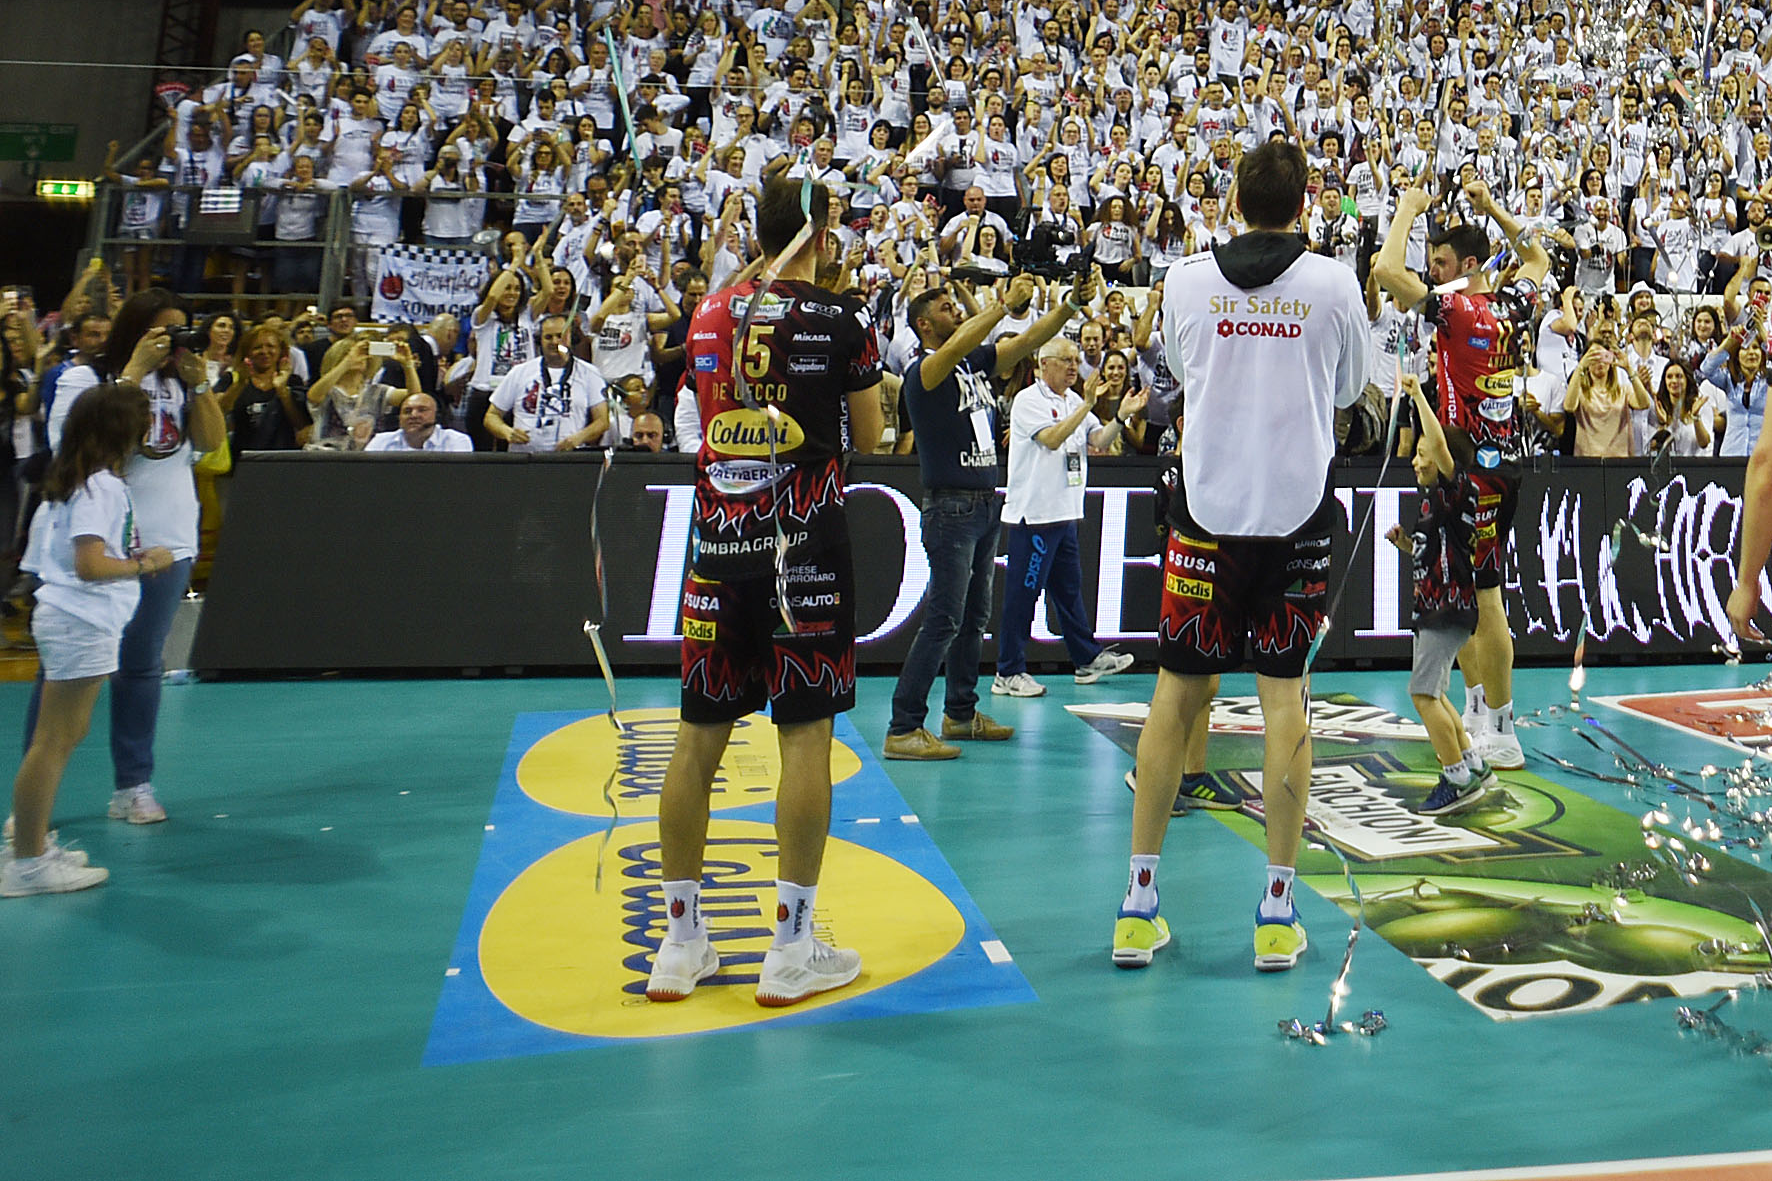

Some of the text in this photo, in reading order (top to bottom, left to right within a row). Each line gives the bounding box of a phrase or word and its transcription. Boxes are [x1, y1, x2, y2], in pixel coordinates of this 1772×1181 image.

[1209, 296, 1312, 320] Sir Safety
[1235, 322, 1302, 338] CONAD
[732, 325, 776, 379] 15
[1024, 552, 1042, 590] asics
[1174, 553, 1216, 575] SUSA
[1176, 578, 1211, 598] Todis
